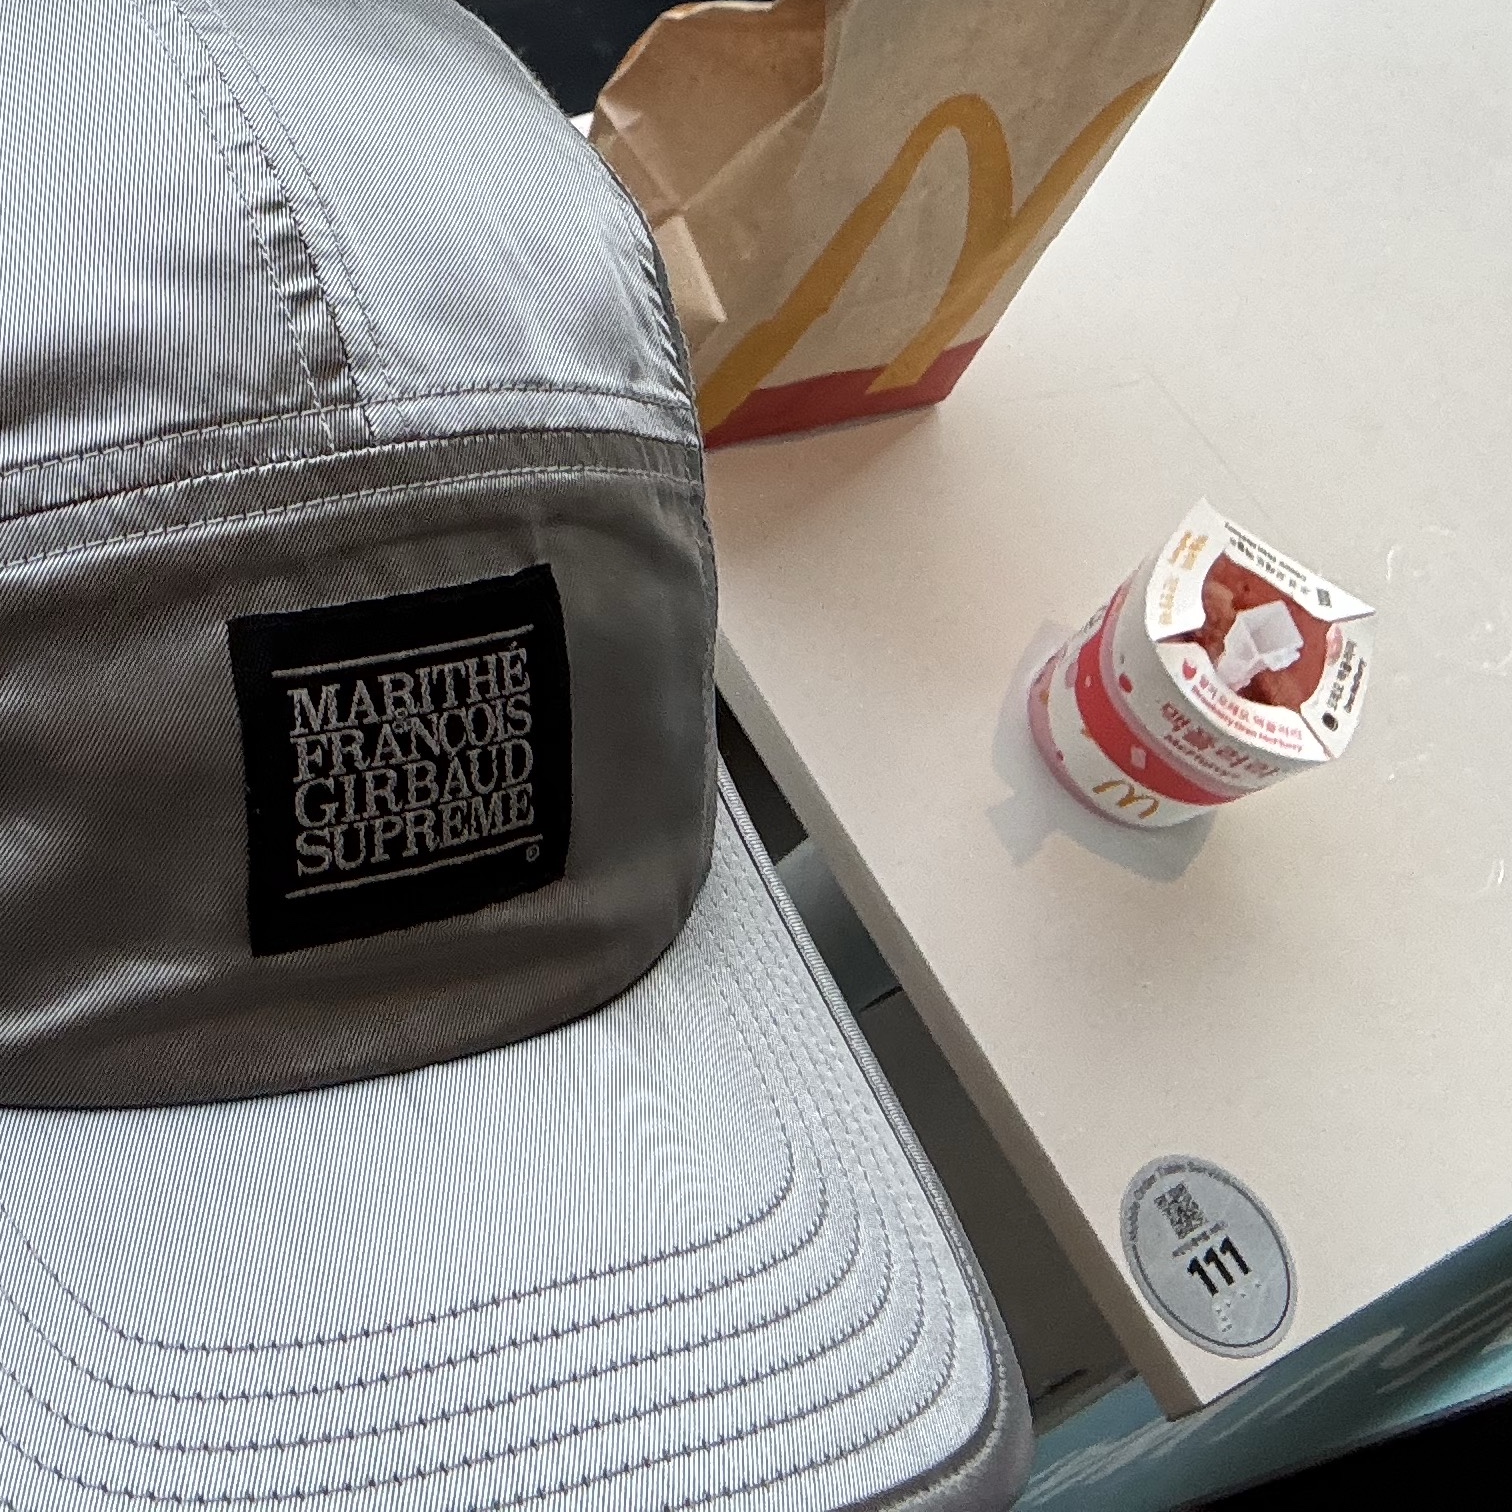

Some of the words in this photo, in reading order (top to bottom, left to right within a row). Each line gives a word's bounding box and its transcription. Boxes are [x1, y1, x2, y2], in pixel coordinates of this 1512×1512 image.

[294, 738, 535, 830] GIRBAUD
[296, 782, 536, 877] SUPREME
[1186, 1235, 1252, 1297] 111
